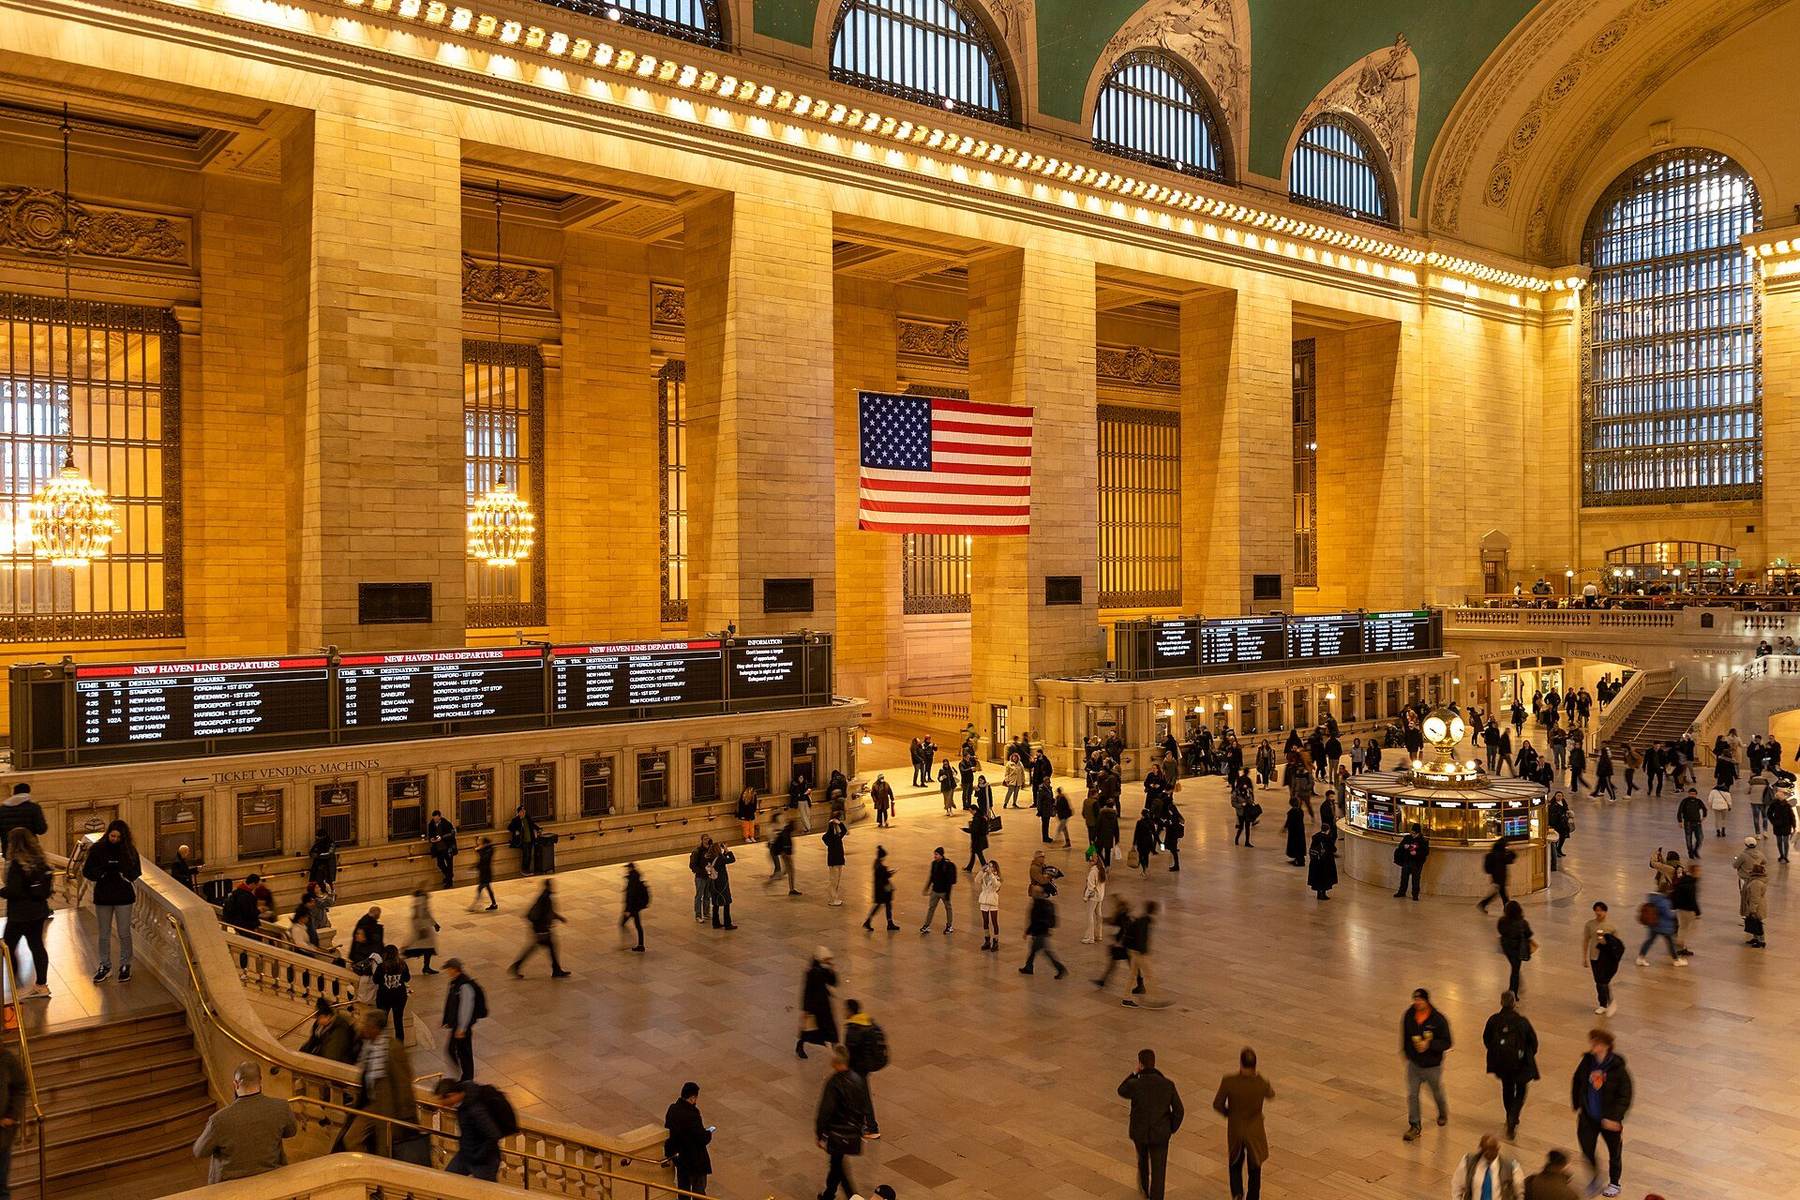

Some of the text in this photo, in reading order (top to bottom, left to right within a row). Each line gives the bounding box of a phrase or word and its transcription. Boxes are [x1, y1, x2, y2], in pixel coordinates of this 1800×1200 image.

[648, 643, 688, 651] DEPARTURES
[455, 650, 503, 660] DEPARTURES
[1480, 648, 1546, 660] TICKET MACHINES
[1570, 650, 1600, 658] SUBWAY
[134, 661, 279, 674] NEW HAVEN LINE DEPARTURES
[212, 759, 380, 783] TICKET VENDING MACHINES
